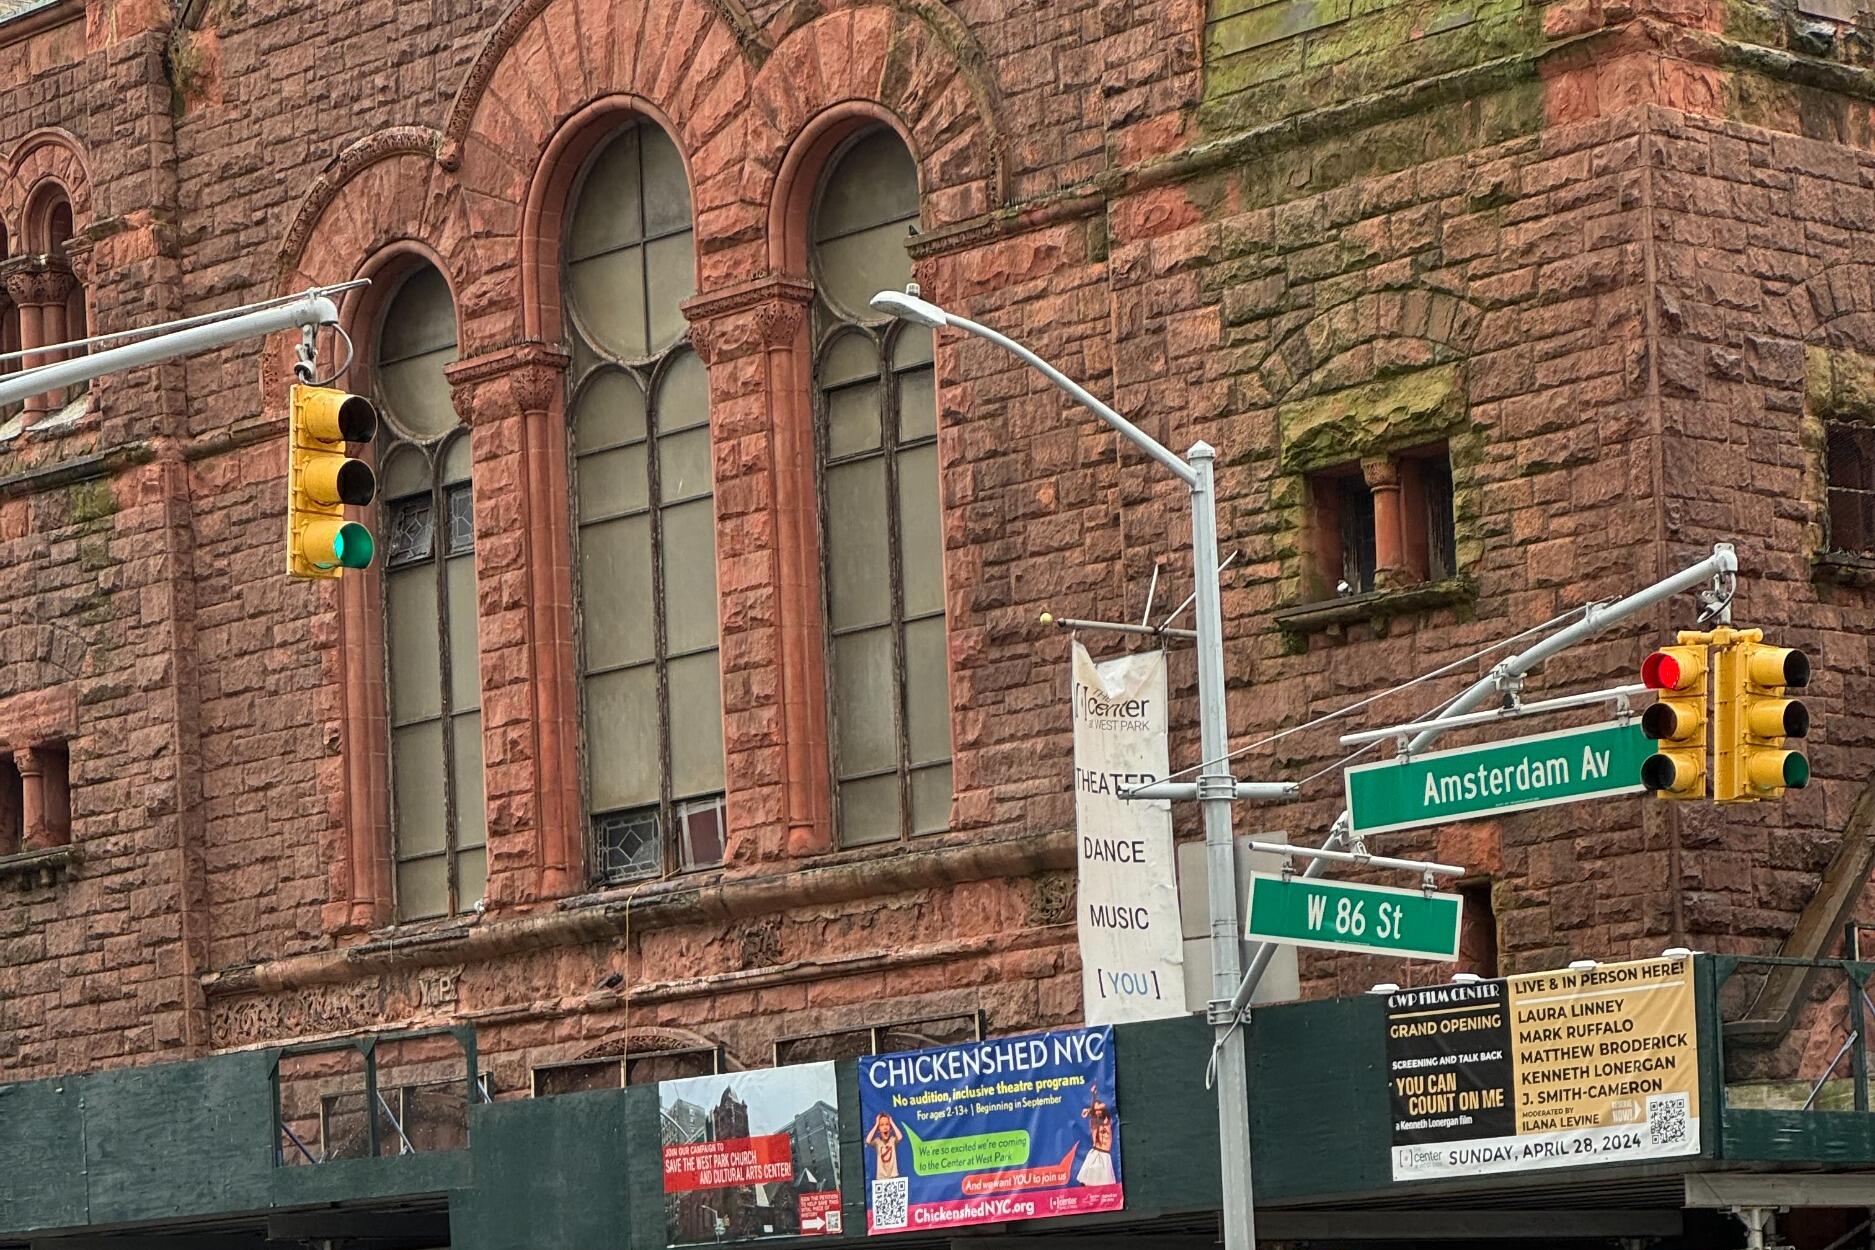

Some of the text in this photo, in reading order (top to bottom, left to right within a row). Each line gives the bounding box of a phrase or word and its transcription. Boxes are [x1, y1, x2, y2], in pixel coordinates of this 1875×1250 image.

[1095, 719, 1118, 731] WEST
[1120, 720, 1150, 731] PARK
[1424, 745, 1611, 806] Amsterdam Av
[1083, 836, 1146, 863] DANCE
[1089, 904, 1149, 930] MUSIC
[1307, 893, 1403, 940] W 86 St
[1515, 962, 1685, 995] LIVE & IN PERSON HERE!
[1388, 984, 1500, 1008] CWP FILM CENTER
[1518, 999, 1625, 1024] LAURA LINNEY
[1390, 1014, 1502, 1038] GRAND OPENING
[1519, 1018, 1634, 1044] MARK RUFFALO
[869, 1033, 1104, 1089] CHICKENSHED NYC
[1392, 1050, 1503, 1070] SCREENING AND TALK BACK
[1521, 1032, 1688, 1065] MATTHEW BRODERICK
[1521, 1055, 1676, 1086] KENNETH LONERGAN
[893, 1075, 1085, 1107] No audition, inclusive theatre programs
[1396, 1072, 1457, 1096] YOU CAN
[1522, 1092, 1534, 1107] J.
[1537, 1078, 1663, 1105] SMITH-CAMERON
[917, 1109, 929, 1120] For
[929, 1107, 946, 1120] ages
[975, 1101, 1014, 1115] Beginning
[1014, 1100, 1021, 1109] in
[1022, 1095, 1062, 1109] September
[1409, 1088, 1505, 1116] COUNT ON ME
[1522, 1107, 1575, 1118] MODERATED BY
[1400, 1120, 1428, 1131] Kenneth
[1459, 1115, 1473, 1125] film
[1522, 1113, 1600, 1131] ILANA LEVINE
[679, 1146, 689, 1156] OUR
[717, 1142, 724, 1152] TO
[919, 1145, 940, 1157] We're
[951, 1143, 976, 1154] excited
[977, 1139, 997, 1150] we're
[998, 1137, 1027, 1148] coming
[1449, 1132, 1642, 1166] SUNDAY, APRIL 28, 2024
[665, 1150, 757, 1174] SAVE THE WEST PARK CHURCH
[919, 1151, 1013, 1171] to the Center at West Park
[700, 1170, 712, 1184] AND
[713, 1167, 744, 1183] CULTURAL
[746, 1164, 762, 1179] ARTS
[965, 1179, 982, 1191] And
[1013, 1173, 1032, 1185] YOU
[1033, 1173, 1041, 1184] to
[1041, 1171, 1057, 1185] join
[1057, 1171, 1067, 1181] us
[914, 1199, 1035, 1224] ChickenshedNYC.org
